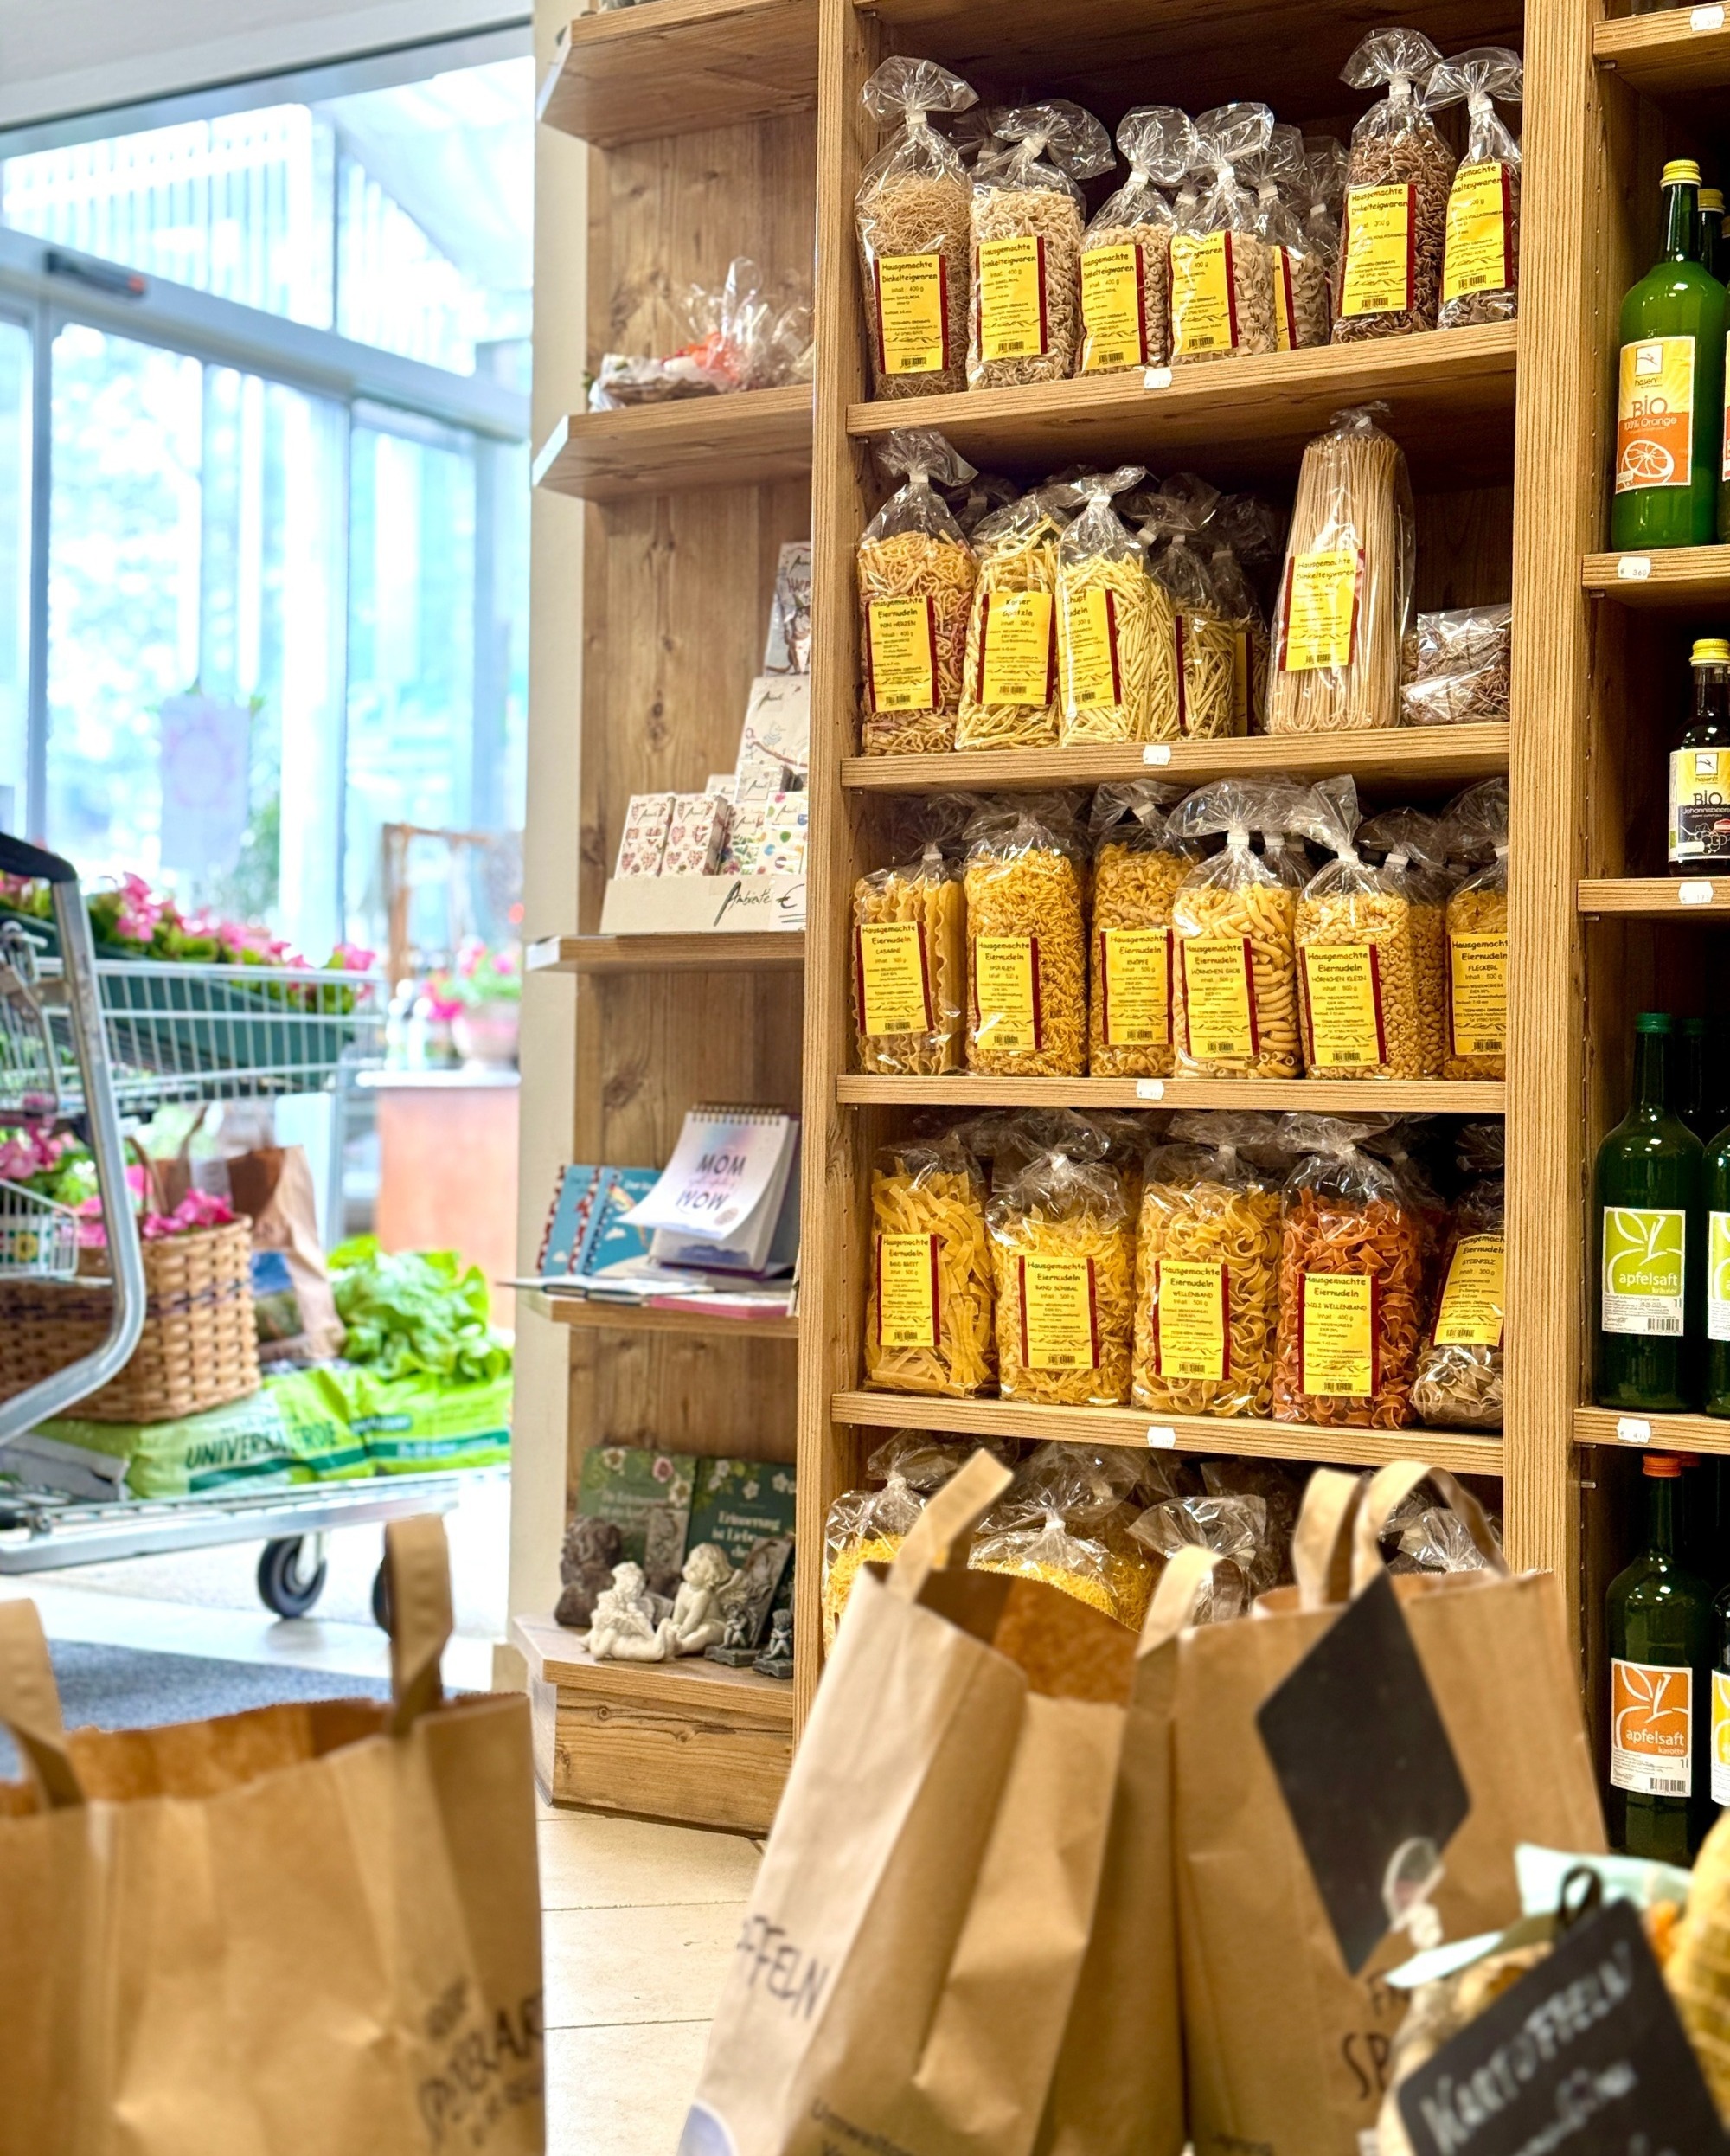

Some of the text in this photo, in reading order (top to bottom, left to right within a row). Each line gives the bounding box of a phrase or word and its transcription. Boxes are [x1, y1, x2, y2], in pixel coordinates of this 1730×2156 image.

[1641, 417, 1676, 427] Orange
[1452, 940, 1508, 950] Hausgemacht
[1195, 956, 1237, 965] Eiernudeln
[1308, 952, 1368, 962] Hausgemachte
[1318, 964, 1362, 972] Eiernudeln
[695, 1153, 746, 1176] MOM
[1028, 1262, 1086, 1271] Hausgemachte
[1162, 1266, 1220, 1276] Hausgemachte
[1170, 1278, 1214, 1287] Eiernudeln
[1619, 1271, 1677, 1287] apfelsaft
[1314, 1287, 1359, 1297] Eiernudeln
[1626, 1729, 1684, 1747] apfelsaft
[1657, 1746, 1684, 1755] karotte
